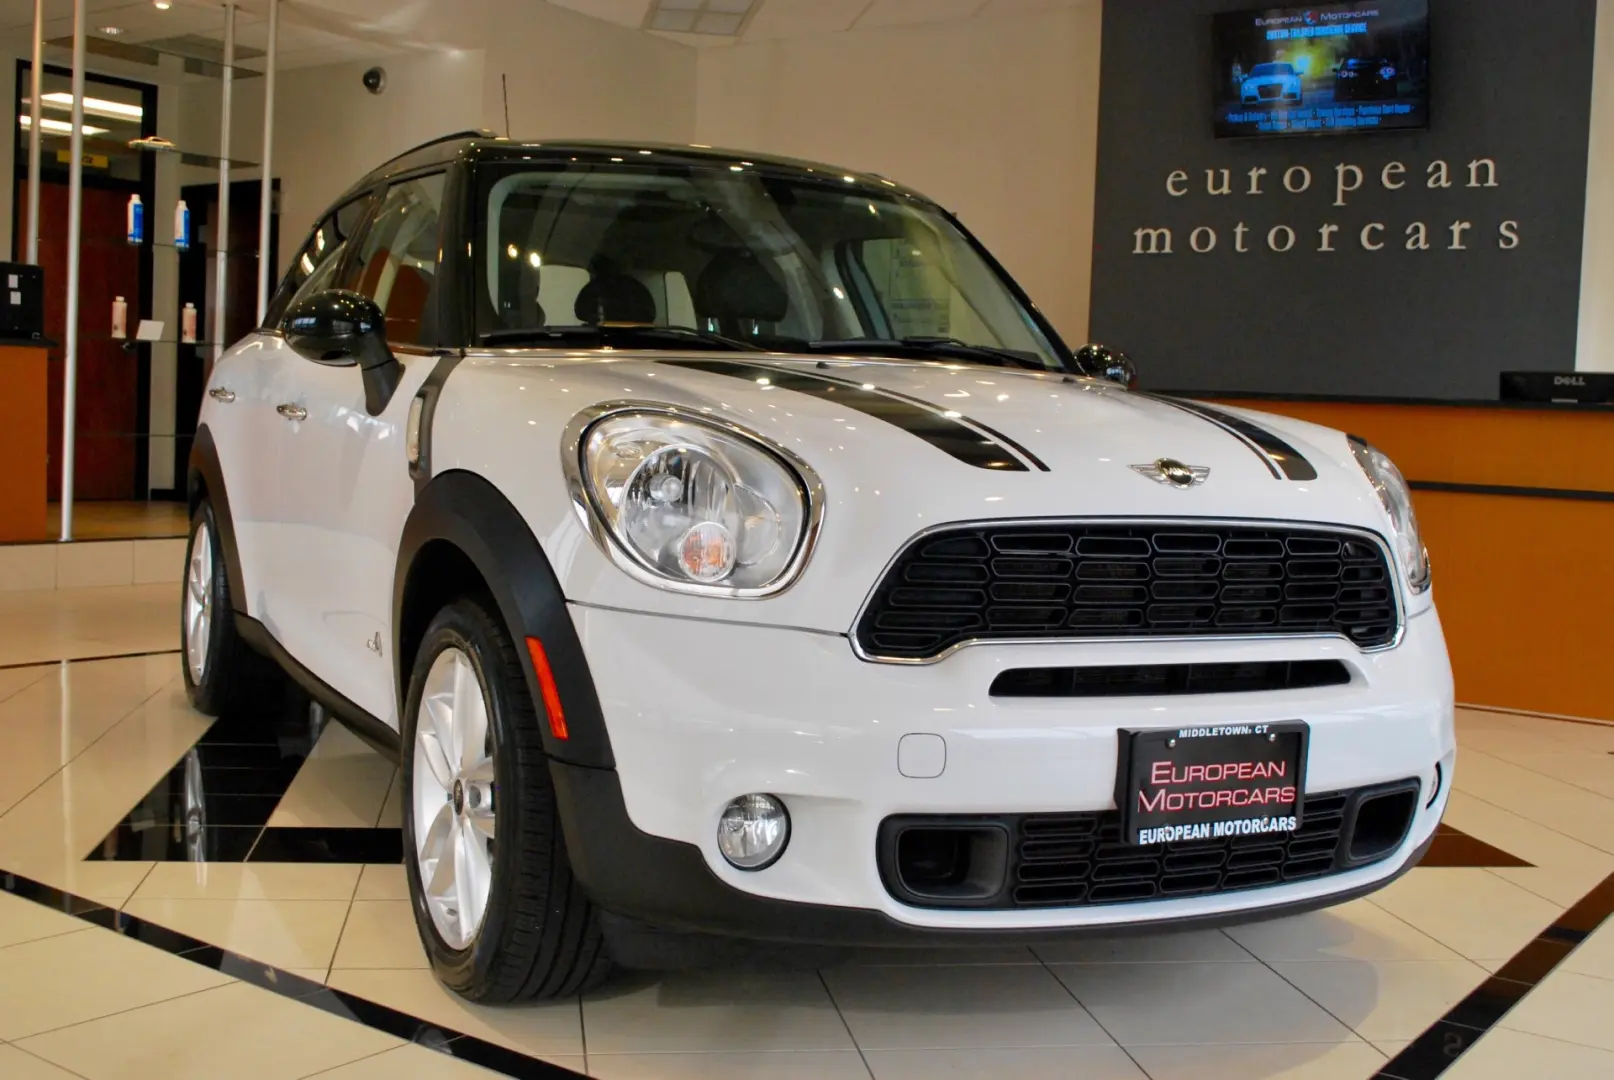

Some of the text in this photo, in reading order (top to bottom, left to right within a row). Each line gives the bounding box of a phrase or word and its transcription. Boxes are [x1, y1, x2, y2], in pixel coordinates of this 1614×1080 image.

[1166, 157, 1499, 206] european
[1132, 219, 1520, 254] motorcars
[1554, 376, 1586, 386] DELL
[1255, 725, 1269, 734] CT
[1151, 761, 1286, 785] EUROPEAN
[1137, 787, 1296, 813] MOTORCARS
[1139, 816, 1297, 845] EUROPEAN MOTORCARS
